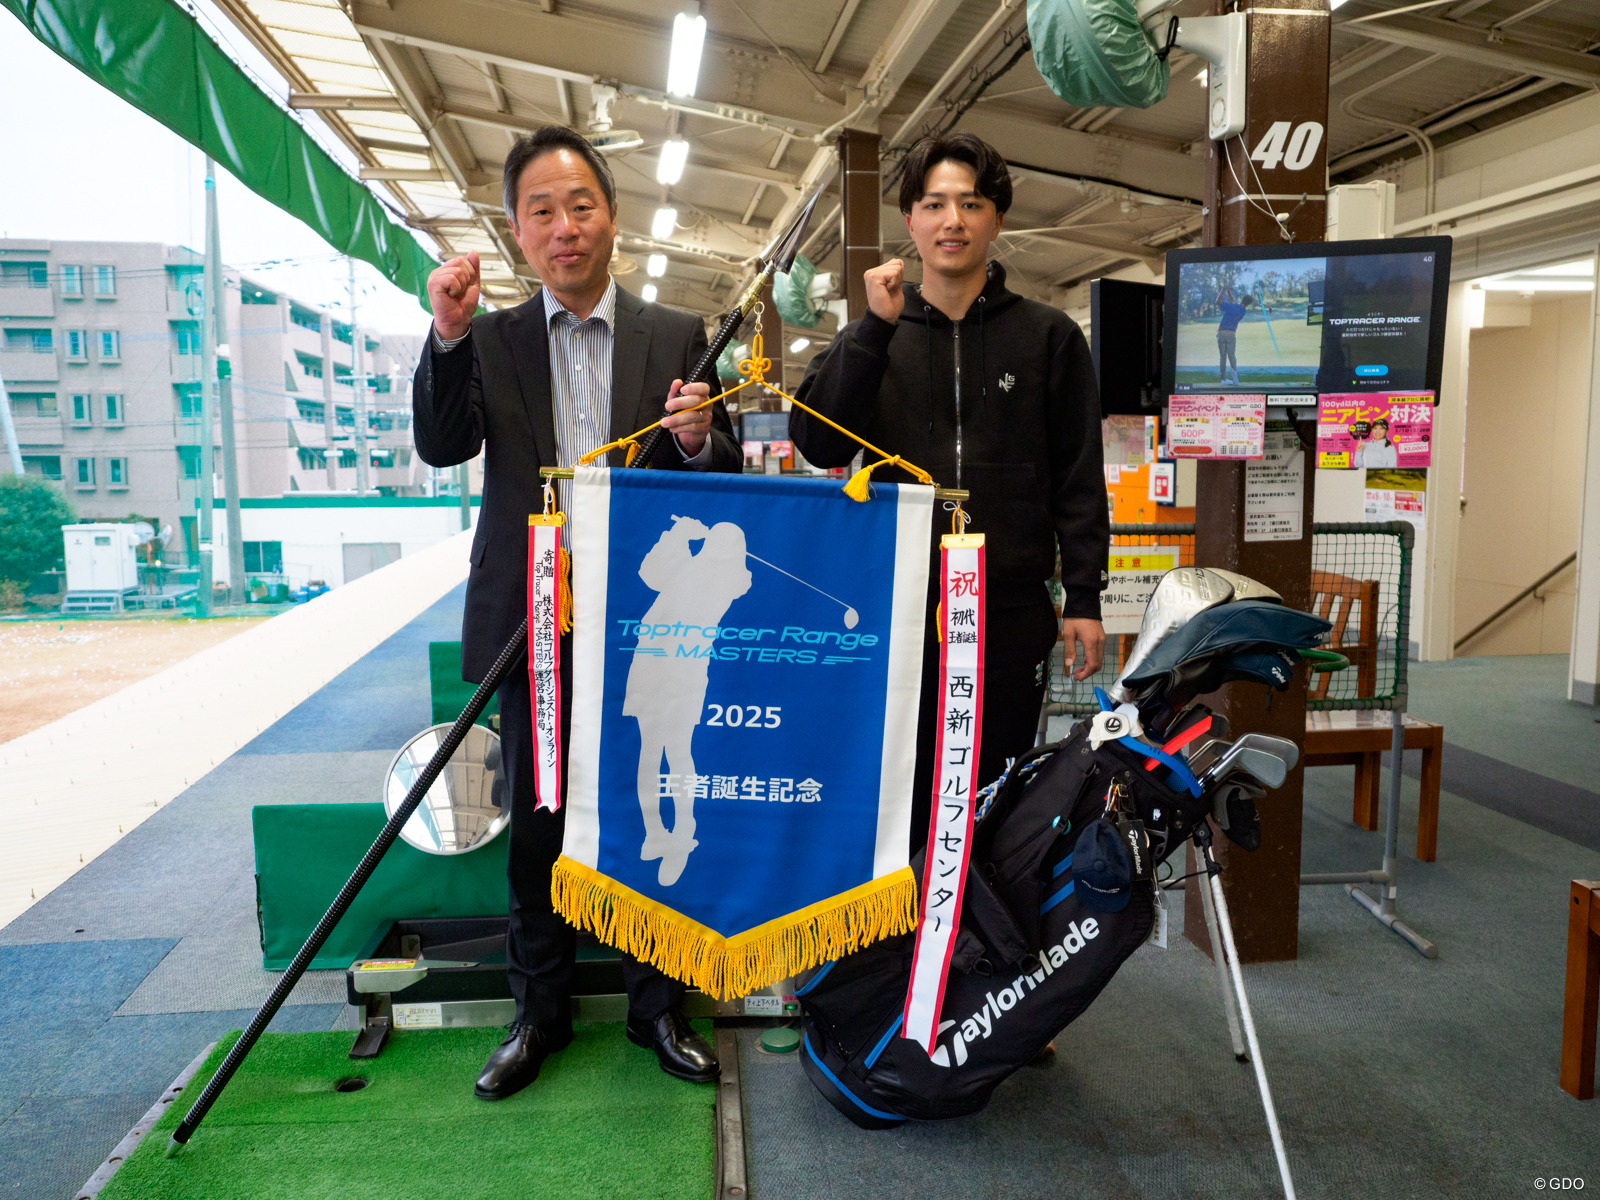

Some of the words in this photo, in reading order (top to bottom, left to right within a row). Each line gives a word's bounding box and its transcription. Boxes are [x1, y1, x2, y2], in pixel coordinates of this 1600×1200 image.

[1251, 121, 1324, 171] 40
[1423, 255, 1433, 263] 40
[1329, 317, 1386, 326] TOPTRACER
[1387, 316, 1421, 324] RANGE
[1321, 399, 1366, 408] 100yd以内の
[1181, 429, 1205, 438] 500P
[543, 549, 555, 578] 寄贈
[1115, 557, 1141, 568] 注意
[948, 570, 979, 598] 祝
[1108, 574, 1165, 585] やボール補充
[950, 607, 975, 627] 初代
[617, 619, 777, 643] Toptracer
[779, 626, 879, 651] Range
[948, 630, 978, 644] 王者誕生
[674, 644, 818, 664] MASTERS
[706, 704, 782, 729] 2025
[655, 773, 824, 803] 王者誕生記念
[931, 675, 974, 932] 西新ゴルフセンター
[1128, 829, 1143, 875] TaylorMade
[931, 916, 1100, 1068] TaylorMade
